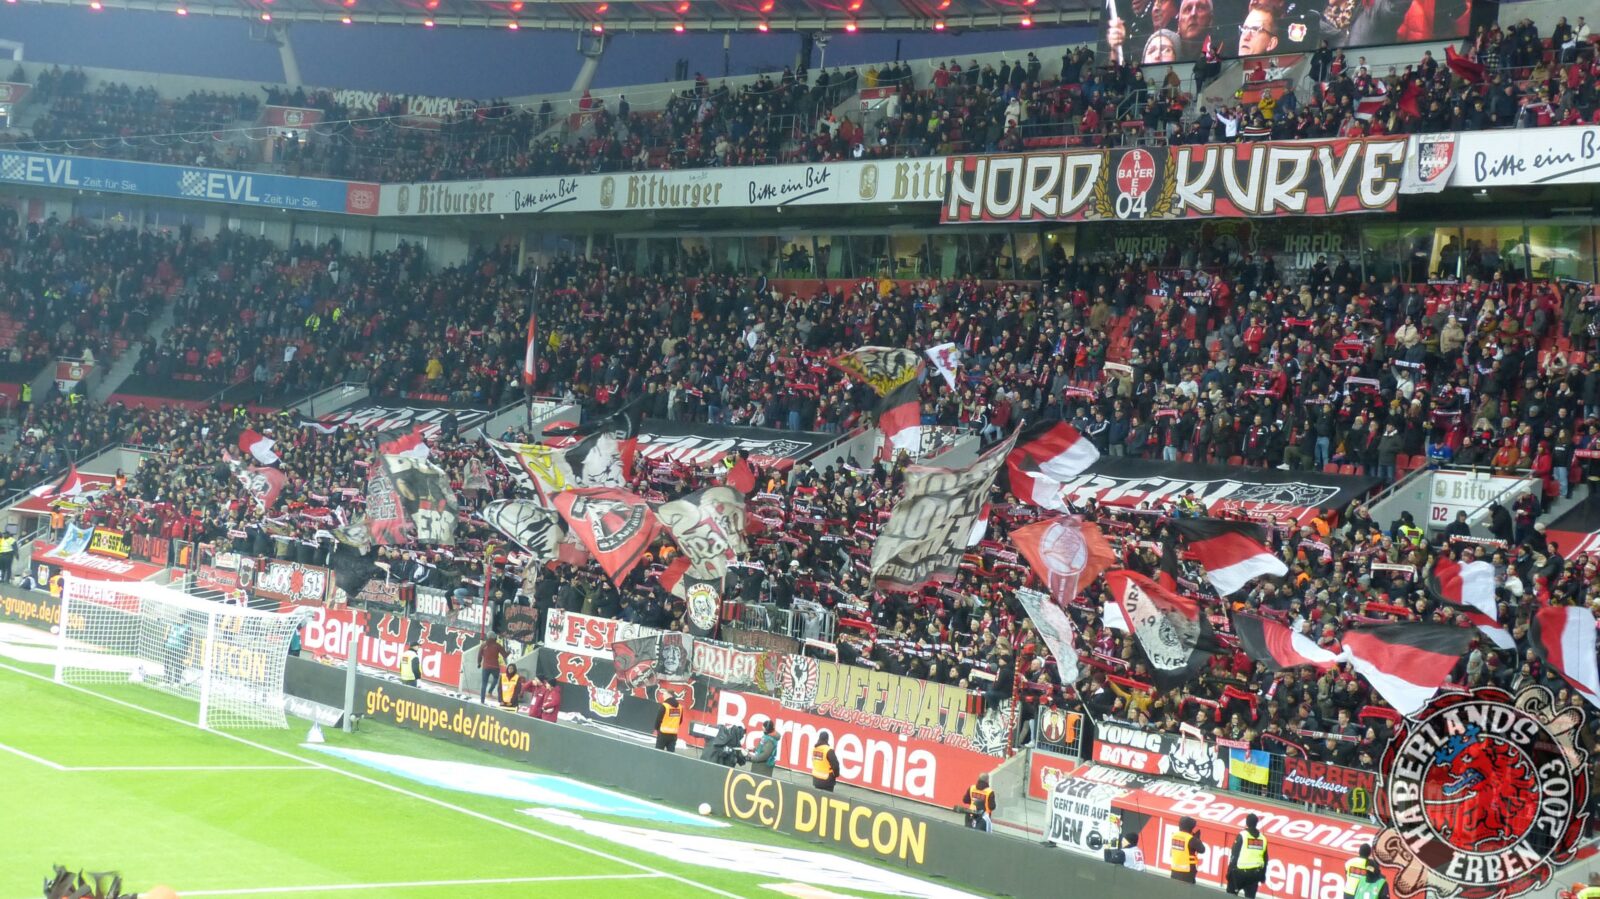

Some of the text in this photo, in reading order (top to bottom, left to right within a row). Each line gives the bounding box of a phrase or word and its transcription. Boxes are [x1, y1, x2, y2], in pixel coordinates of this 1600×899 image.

[407, 95, 458, 118] LÖWEN
[25, 156, 79, 186] EVL
[83, 176, 102, 188] Zeit
[1474, 151, 1527, 183] Bitte
[1533, 148, 1575, 168] ein
[1581, 130, 1600, 159] B
[207, 172, 260, 202] EVL
[263, 193, 283, 204] Zeit
[749, 166, 831, 204] Bitte ein Bit
[891, 161, 947, 200] Bitb
[948, 153, 1102, 217] NORD
[1175, 139, 1406, 212] KURVE
[1118, 168, 1153, 178] BAYER
[417, 183, 496, 215] Bitburger
[514, 178, 579, 212] Bitte ein Bit
[625, 174, 723, 209] Bitburger
[1115, 191, 1148, 219] 04
[1432, 506, 1448, 521] D2
[366, 686, 531, 752] gfc-gruppe.de/ditcon
[1095, 723, 1162, 753] YOUNG
[1099, 744, 1149, 770] BOYS
[1055, 778, 1098, 799] DER
[1284, 757, 1375, 792] FARBEN
[1285, 769, 1348, 794] Leverkusen
[1053, 796, 1074, 812] GEHT
[1091, 806, 1109, 821] AUF
[1170, 792, 1377, 853] Barmenia
[794, 790, 927, 864] DITCON
[1051, 813, 1084, 845] DEN
